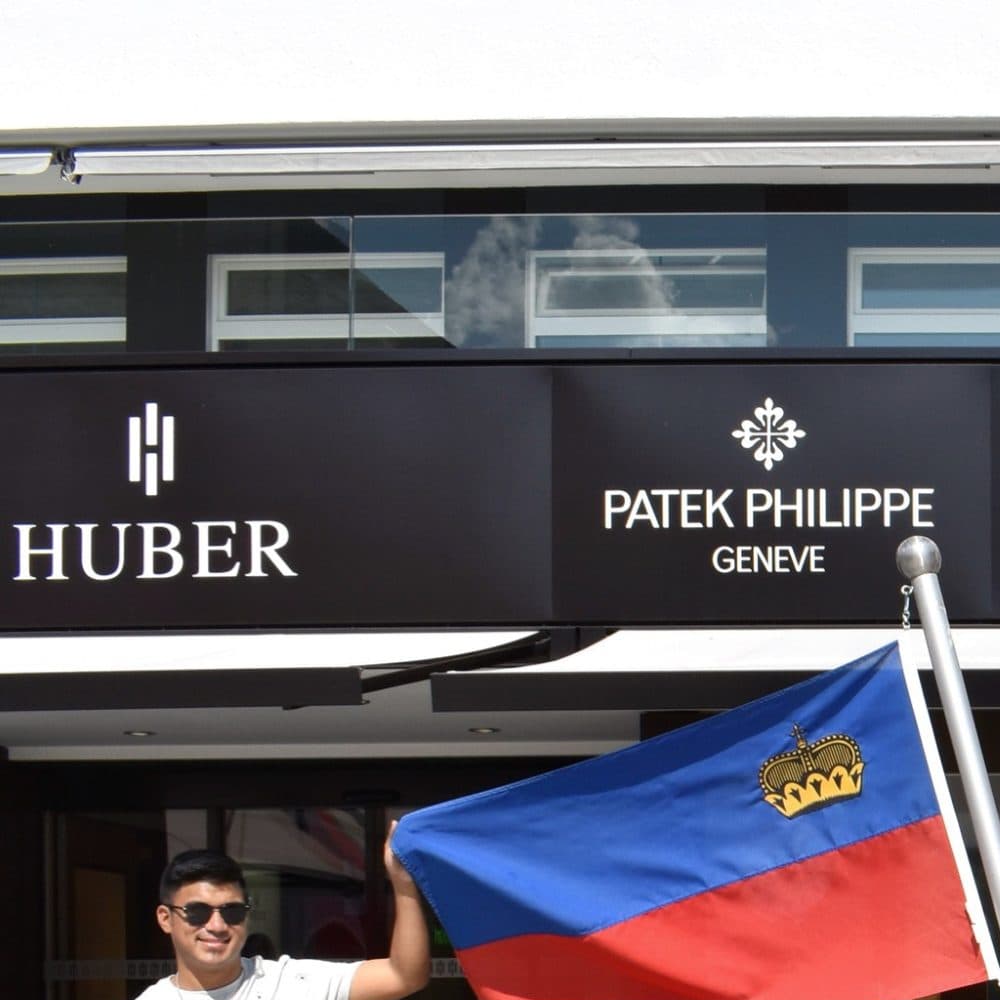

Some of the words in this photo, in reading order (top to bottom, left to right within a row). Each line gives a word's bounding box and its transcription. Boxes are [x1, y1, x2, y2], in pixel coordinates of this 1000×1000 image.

[604, 488, 735, 529] PATEK
[746, 488, 935, 528] PHILIPPE
[13, 519, 299, 581] HUBER
[712, 545, 826, 573] GENEVE
